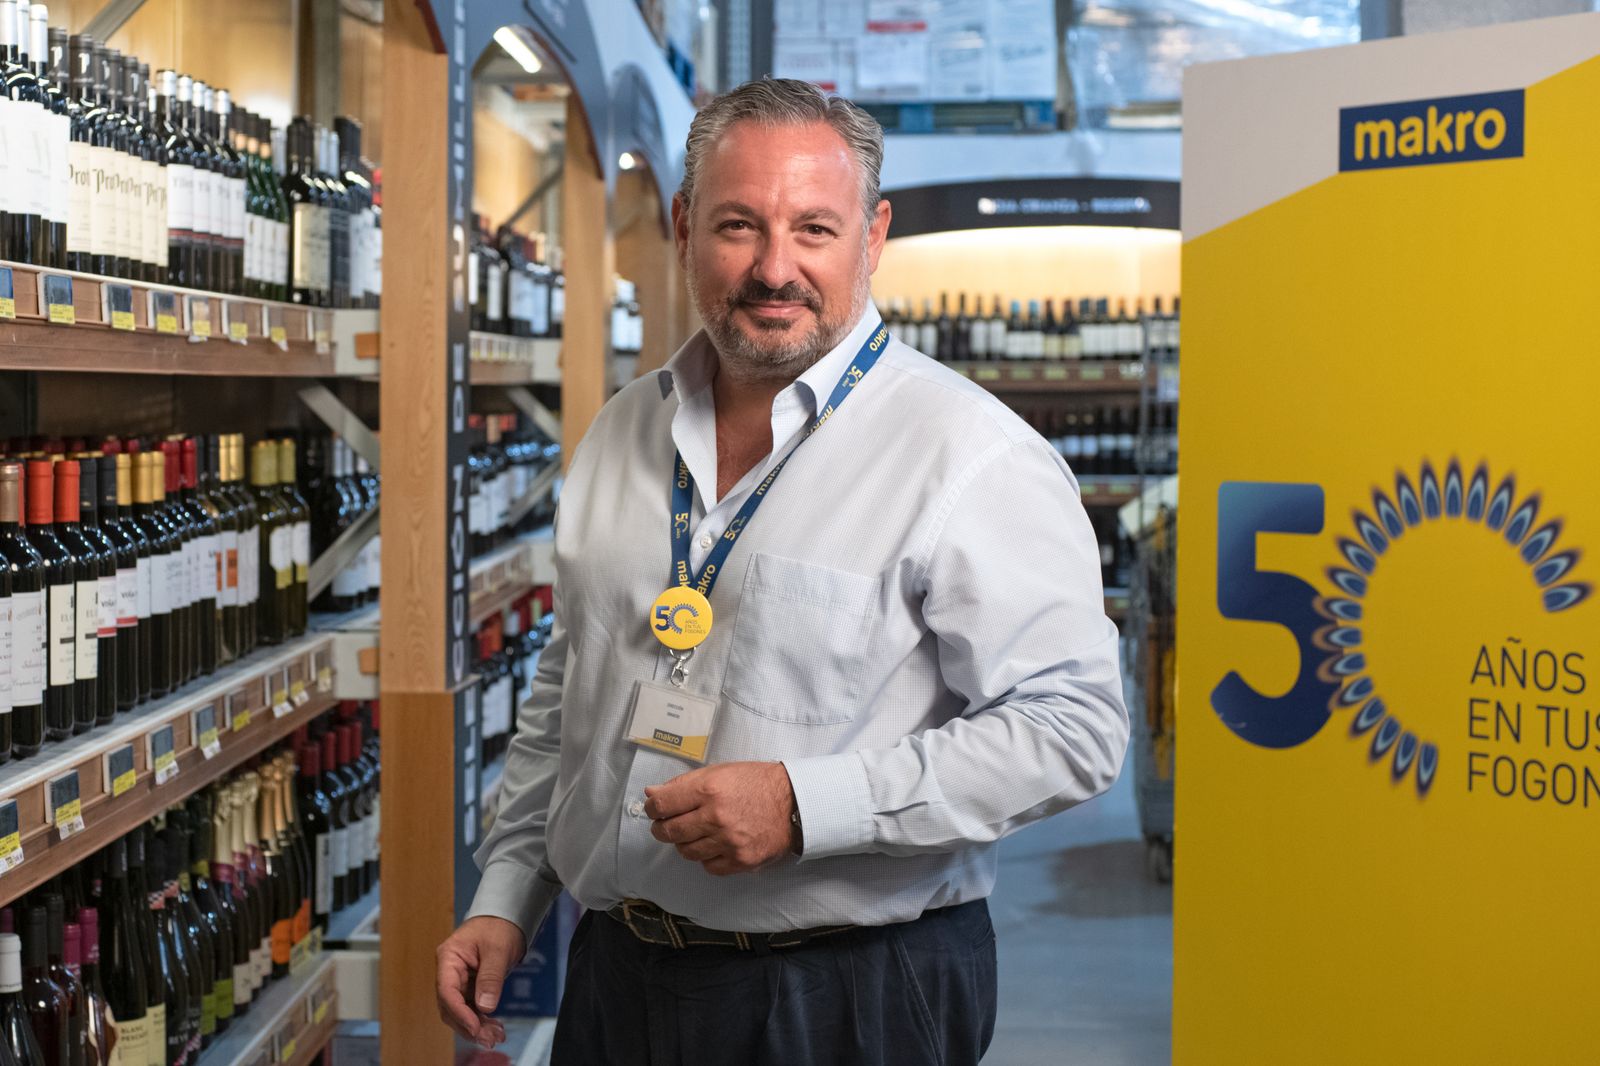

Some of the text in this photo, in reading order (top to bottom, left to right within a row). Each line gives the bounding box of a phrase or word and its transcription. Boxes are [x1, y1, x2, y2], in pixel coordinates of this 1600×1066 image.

[1354, 105, 1507, 161] makro
[697, 564, 716, 595] akro
[1471, 636, 1586, 694] AÑOS
[655, 731, 680, 744] makro
[1469, 697, 1600, 752] EN TU
